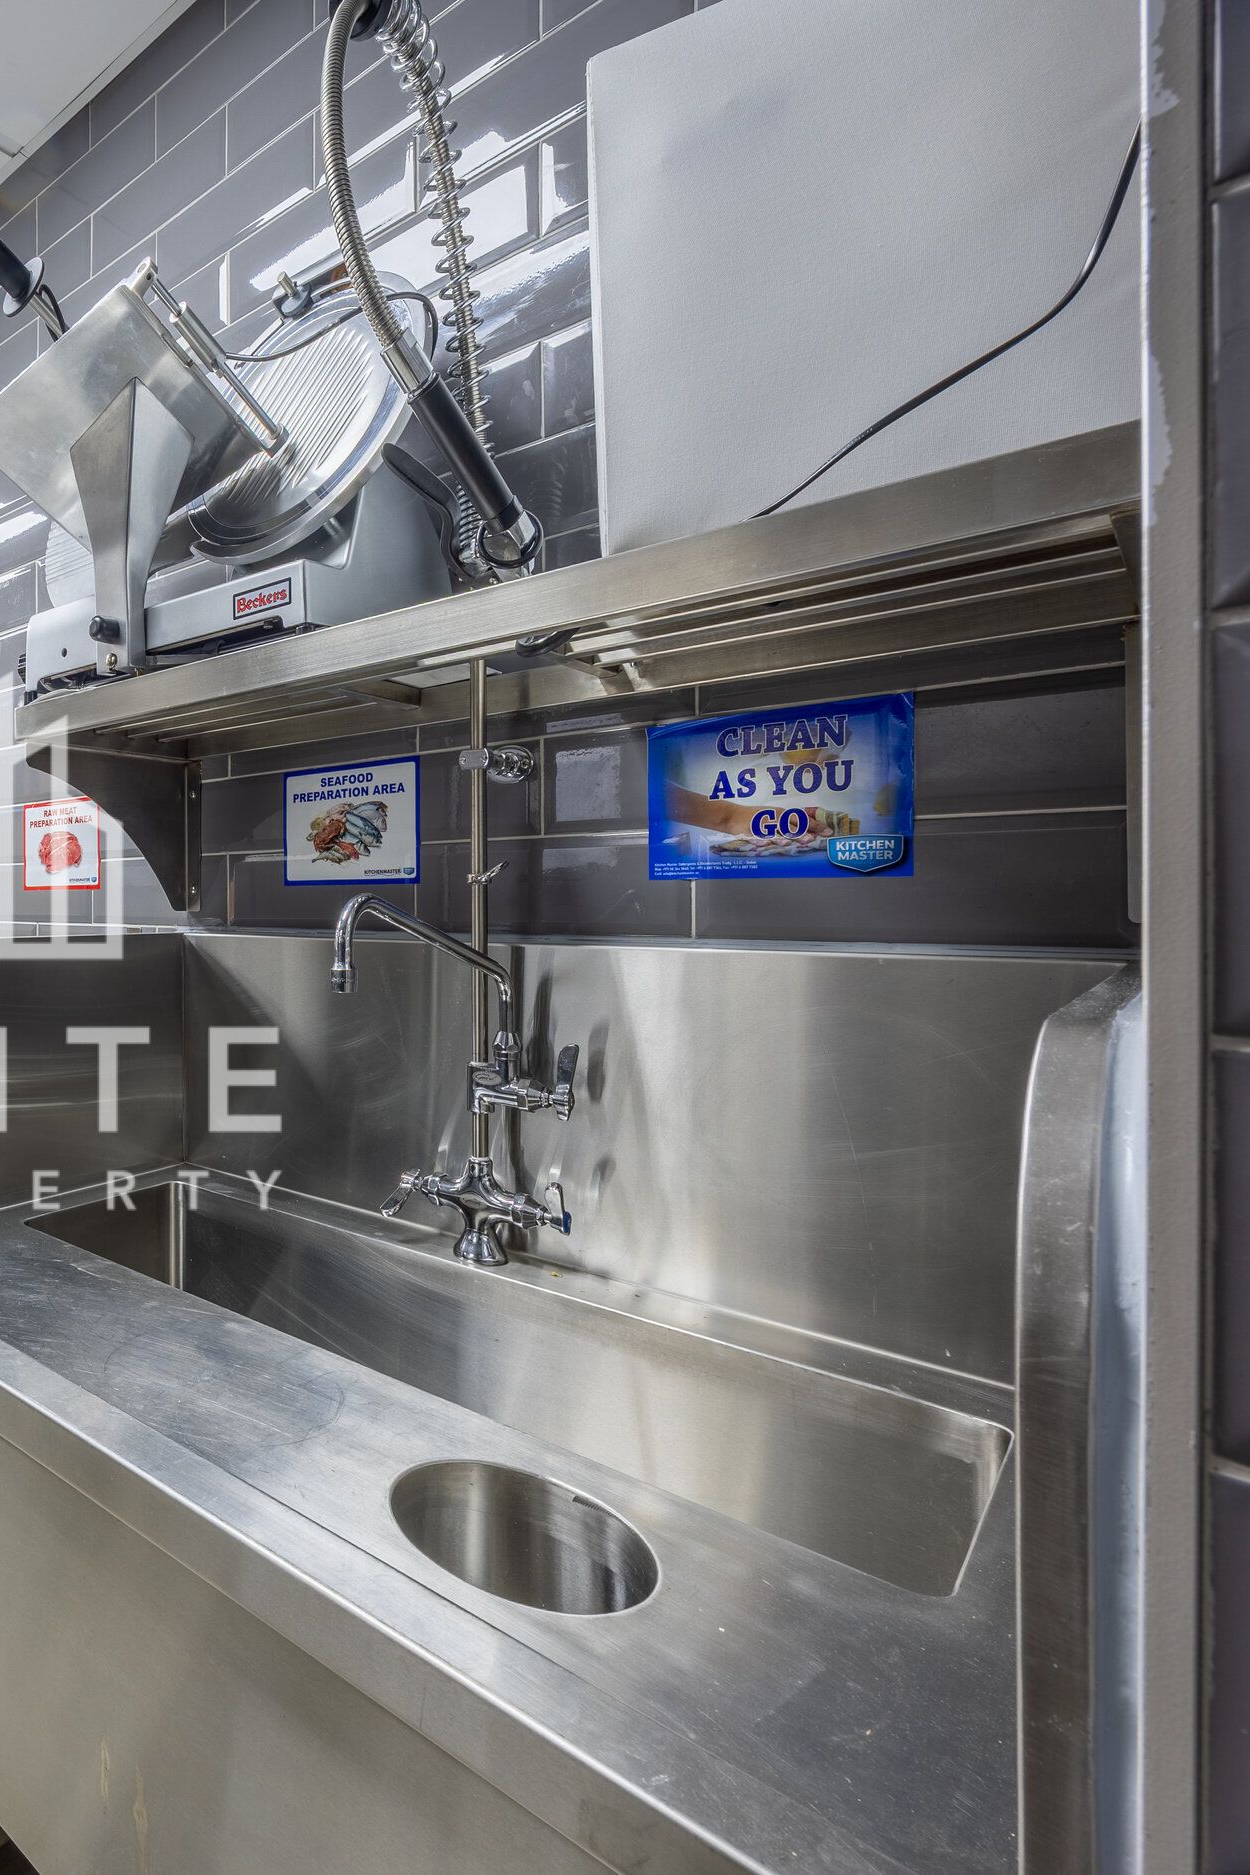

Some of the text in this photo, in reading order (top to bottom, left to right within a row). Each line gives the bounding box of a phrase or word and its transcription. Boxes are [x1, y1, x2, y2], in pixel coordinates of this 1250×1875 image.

[237, 588, 287, 613] Beckers
[716, 714, 849, 758] CLEAN
[320, 772, 373, 787] SEAFOOD
[708, 759, 854, 800] AS YOU
[293, 782, 405, 803] PREPARATION AREA
[29, 815, 92, 828] PREPARATION AREA
[43, 807, 77, 818] RAW MEAT
[751, 808, 810, 839] GO
[835, 839, 895, 851] KITCHEN
[837, 850, 893, 862] MASTER
